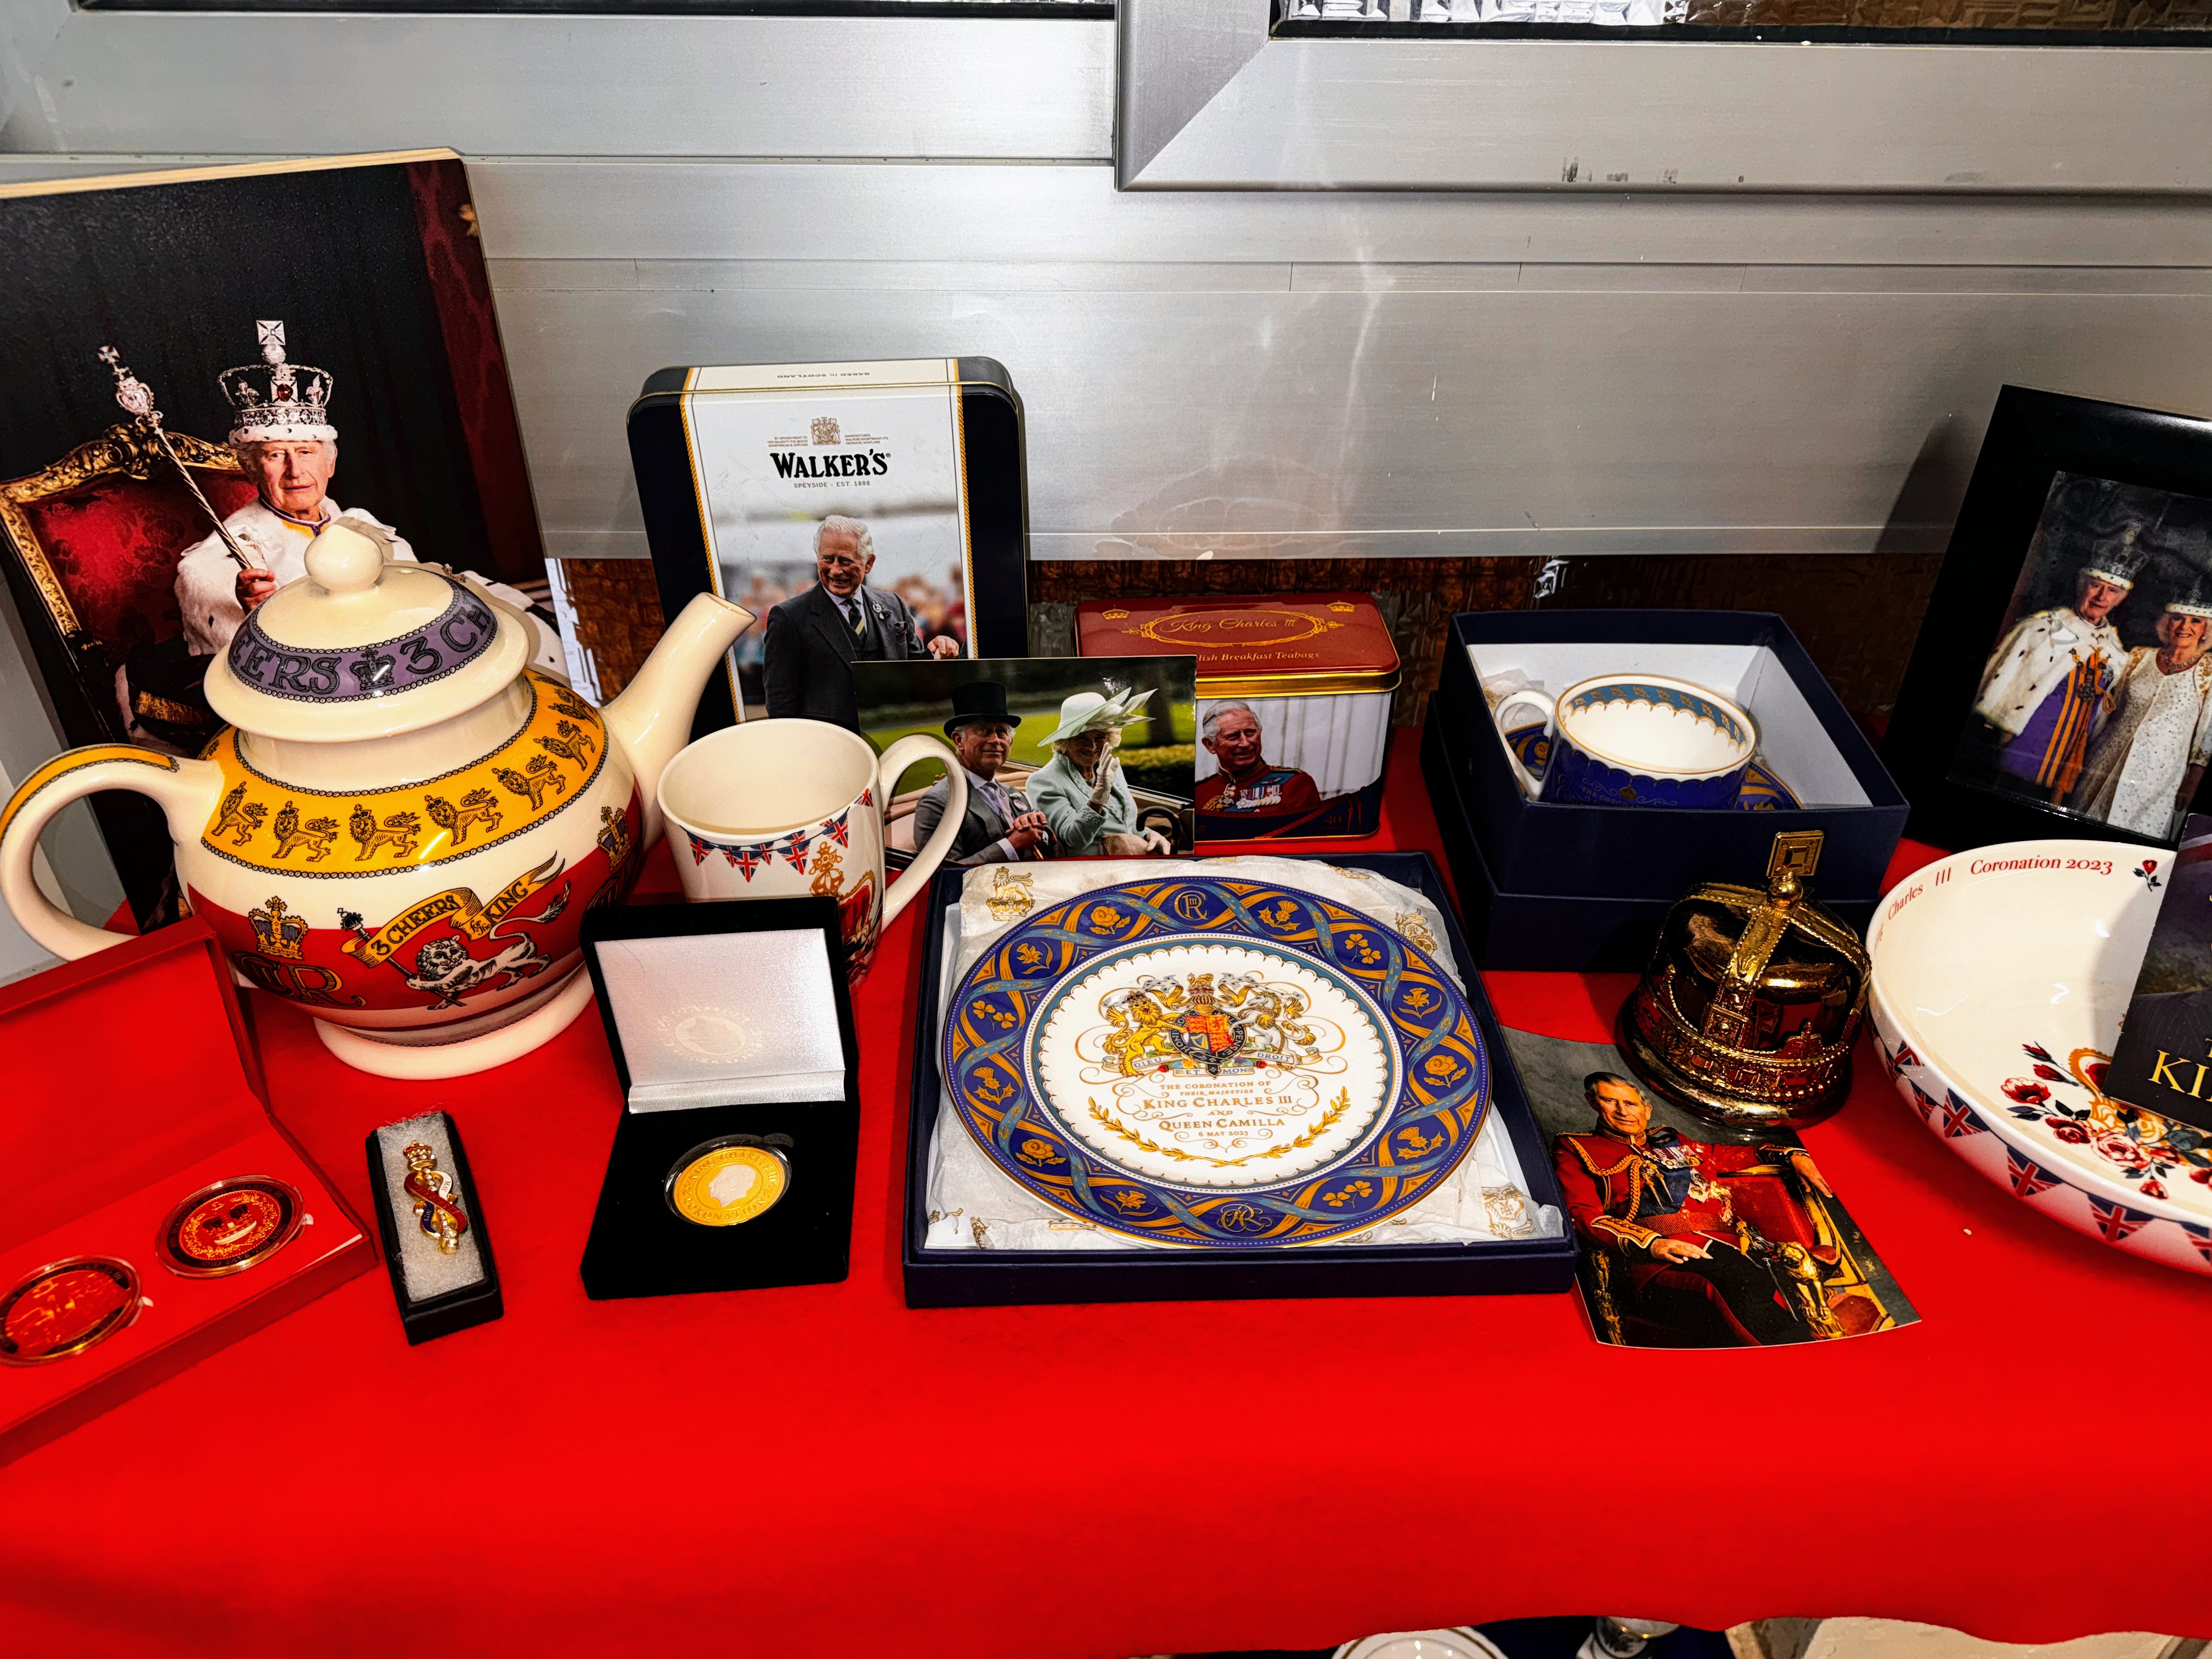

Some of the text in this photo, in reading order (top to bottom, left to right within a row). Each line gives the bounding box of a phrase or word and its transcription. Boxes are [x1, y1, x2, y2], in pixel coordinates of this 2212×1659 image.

[1160, 619, 1214, 633] King
[1219, 619, 1277, 629] Charles
[399, 636, 443, 674] 3
[1221, 652, 1272, 662] Breakfast
[1275, 651, 1319, 659] Teabags
[1888, 884, 1923, 920] Charles
[1936, 867, 1951, 886] III
[1971, 855, 2061, 874] Coronation
[2065, 859, 2113, 875] 2023
[481, 881, 529, 928] KING
[371, 895, 461, 956] 3 CHEERS
[1133, 1057, 1161, 1068] DIEU
[1257, 1052, 1291, 1062] DROIT
[2148, 1049, 2212, 1102] KI
[1143, 1096, 1292, 1109] KING CHARLES III
[1159, 1119, 1285, 1132] QUEEN CAMILLA
[442, 1181, 450, 1192] MAY
